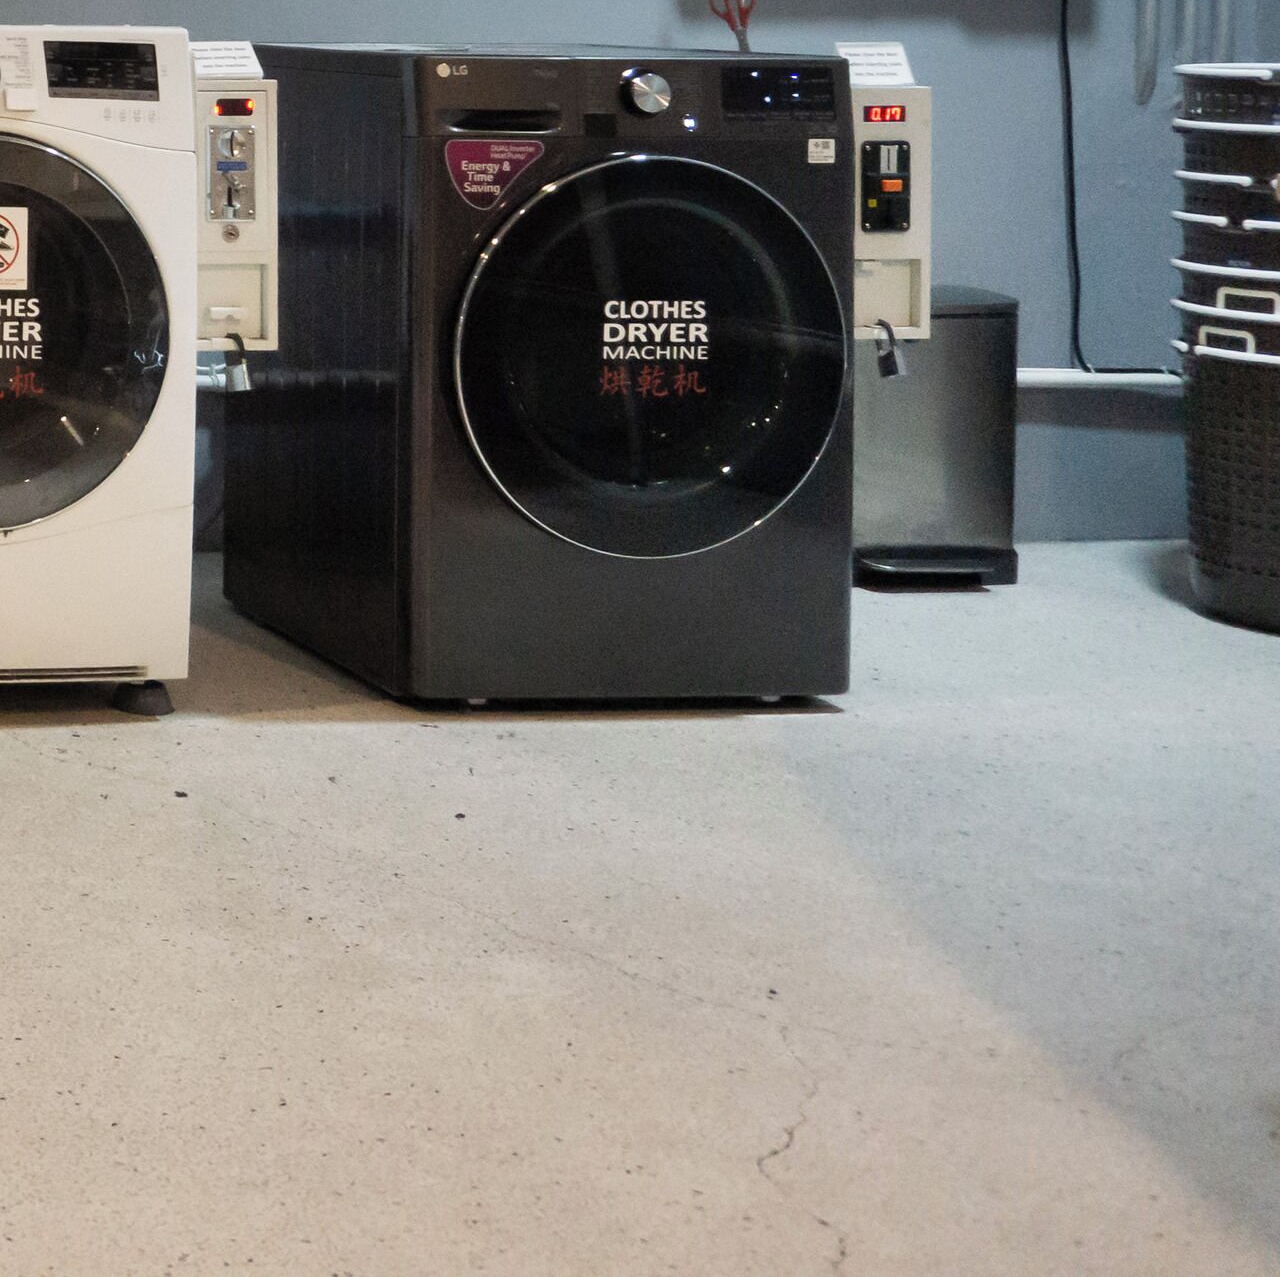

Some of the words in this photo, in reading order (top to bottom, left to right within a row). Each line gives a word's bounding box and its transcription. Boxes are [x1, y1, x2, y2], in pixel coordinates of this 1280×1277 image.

[452, 65, 468, 76] LG
[461, 160, 500, 174] Energy
[502, 161, 511, 172] &
[467, 171, 494, 182] Time
[464, 182, 501, 195] Saving
[604, 300, 706, 319] CLOTHES
[603, 323, 709, 343] DRYER
[602, 345, 709, 360] MACHINE
[600, 364, 706, 397] 烘乾机
